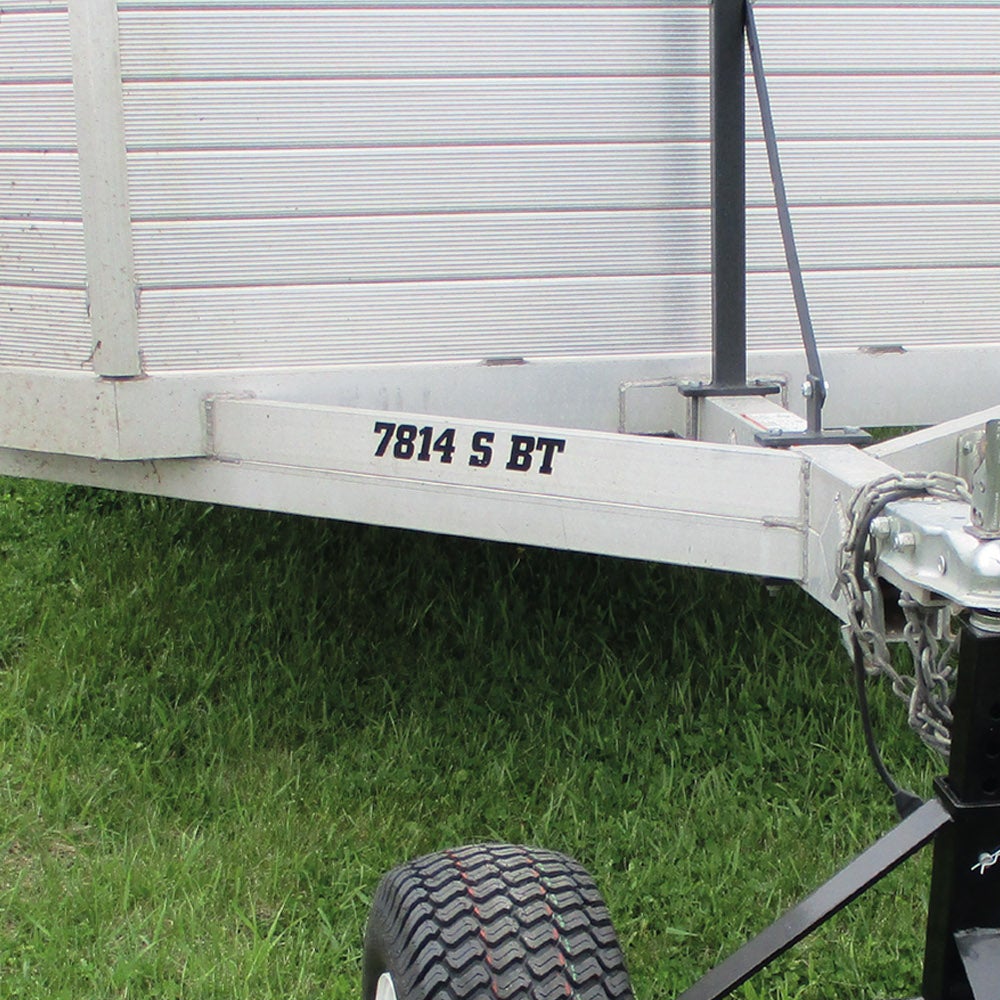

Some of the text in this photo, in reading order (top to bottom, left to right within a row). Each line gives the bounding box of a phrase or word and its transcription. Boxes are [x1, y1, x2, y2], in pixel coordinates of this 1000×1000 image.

[374, 421, 566, 475] 7814 S BT
